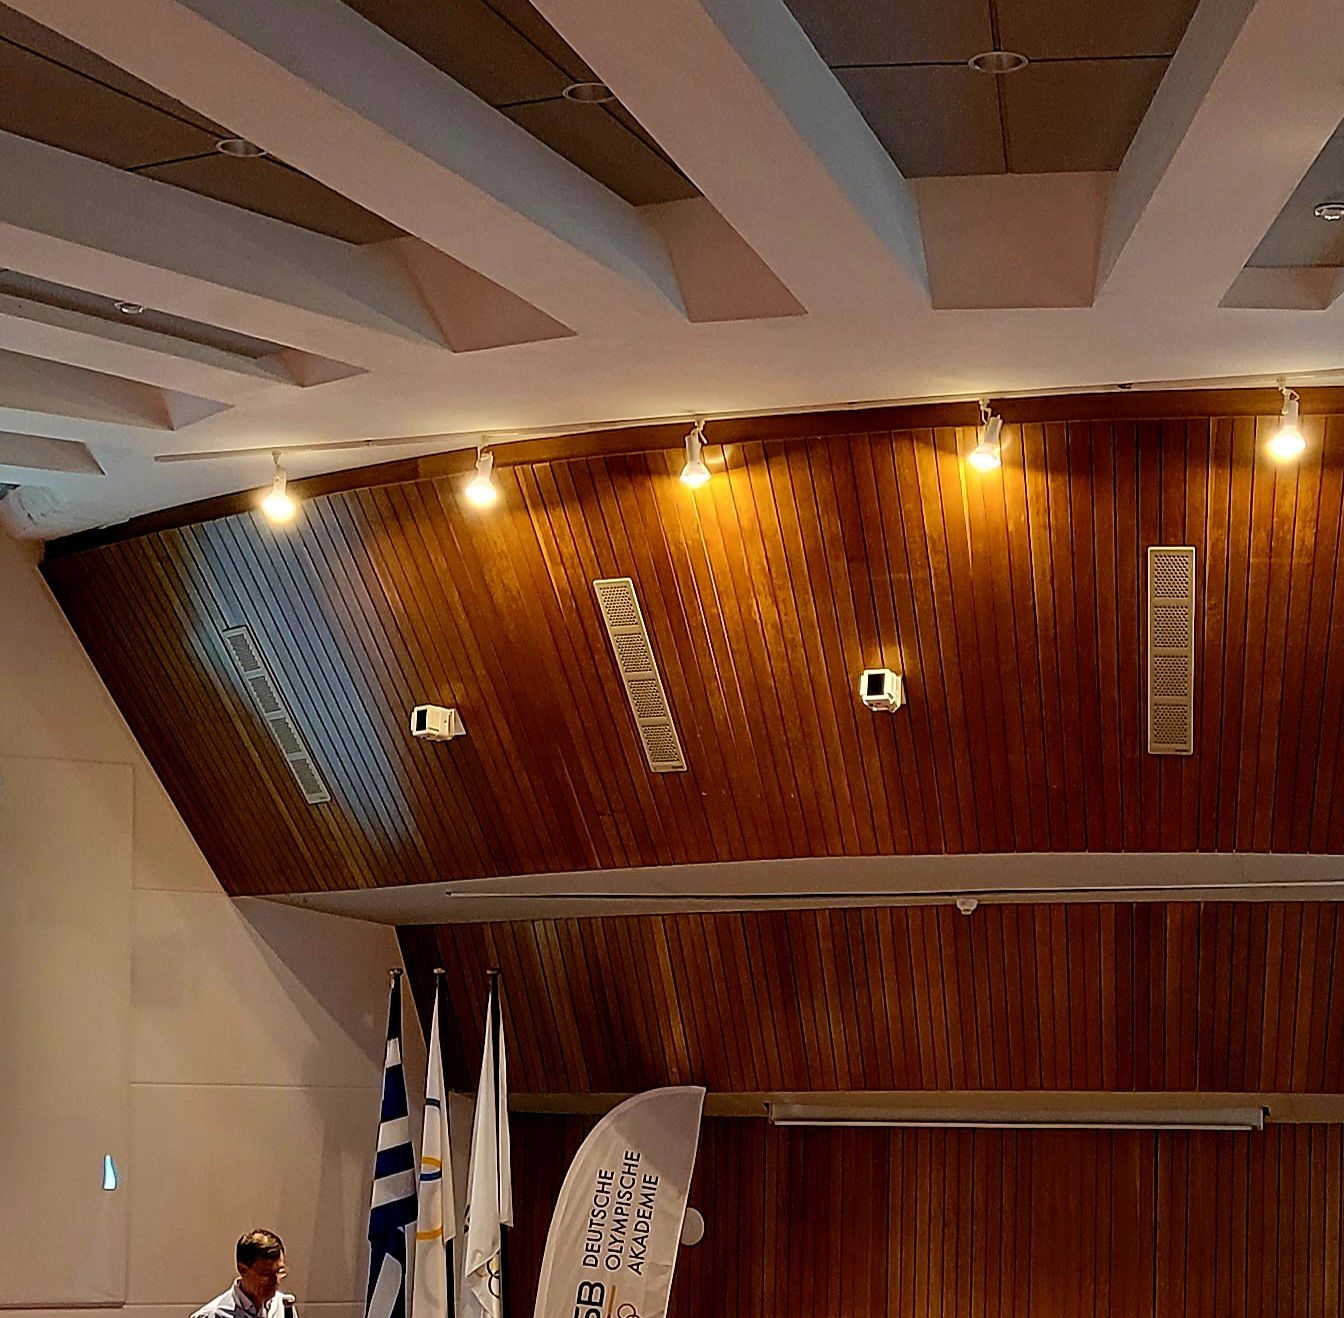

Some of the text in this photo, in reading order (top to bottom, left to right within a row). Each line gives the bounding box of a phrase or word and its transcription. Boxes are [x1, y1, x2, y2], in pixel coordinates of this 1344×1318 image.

[583, 1169, 614, 1268] DEUTSCHE
[605, 1150, 641, 1271] OLYMPISCHE
[627, 1174, 659, 1275] AKADEMIE
